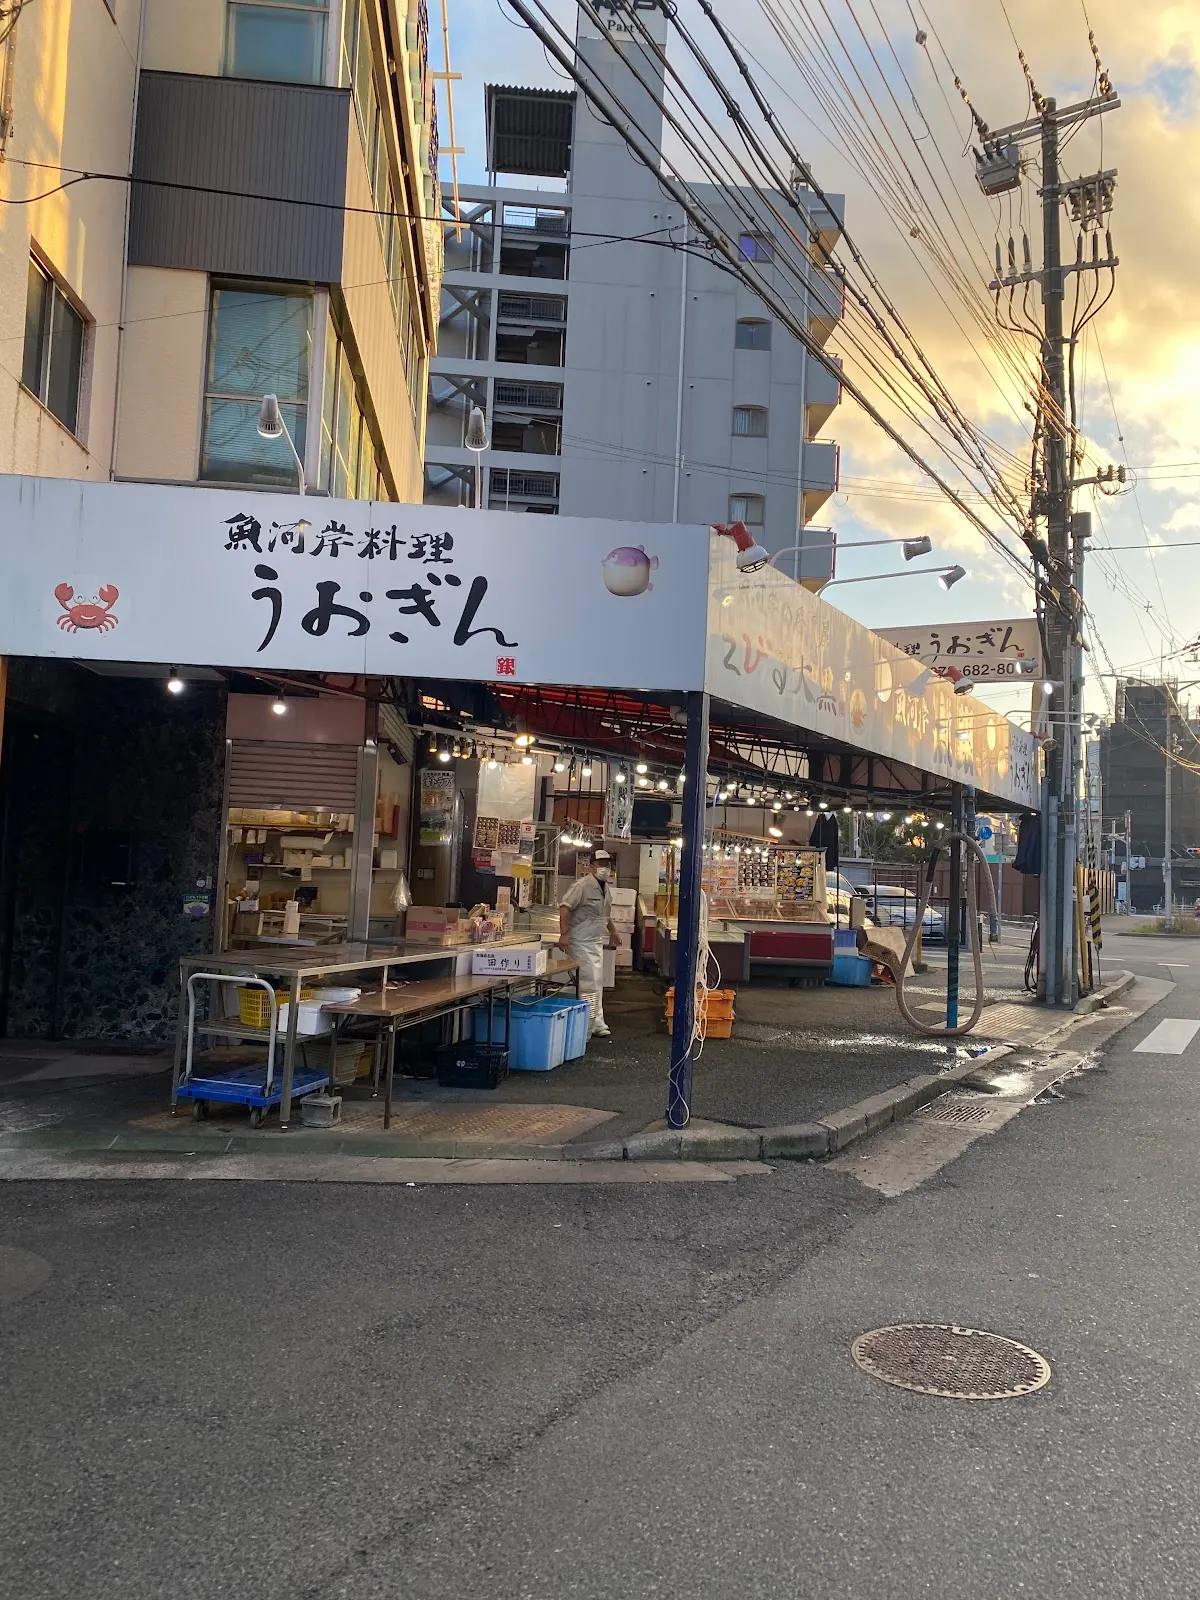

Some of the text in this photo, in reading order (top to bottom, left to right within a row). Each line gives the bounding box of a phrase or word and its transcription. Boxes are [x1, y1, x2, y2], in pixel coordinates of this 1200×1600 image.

[220, 512, 454, 564] 魚河岸料理
[252, 564, 518, 652] うおぎん
[930, 626, 1025, 663] うおぎん
[487, 958, 520, 969] 田作り
